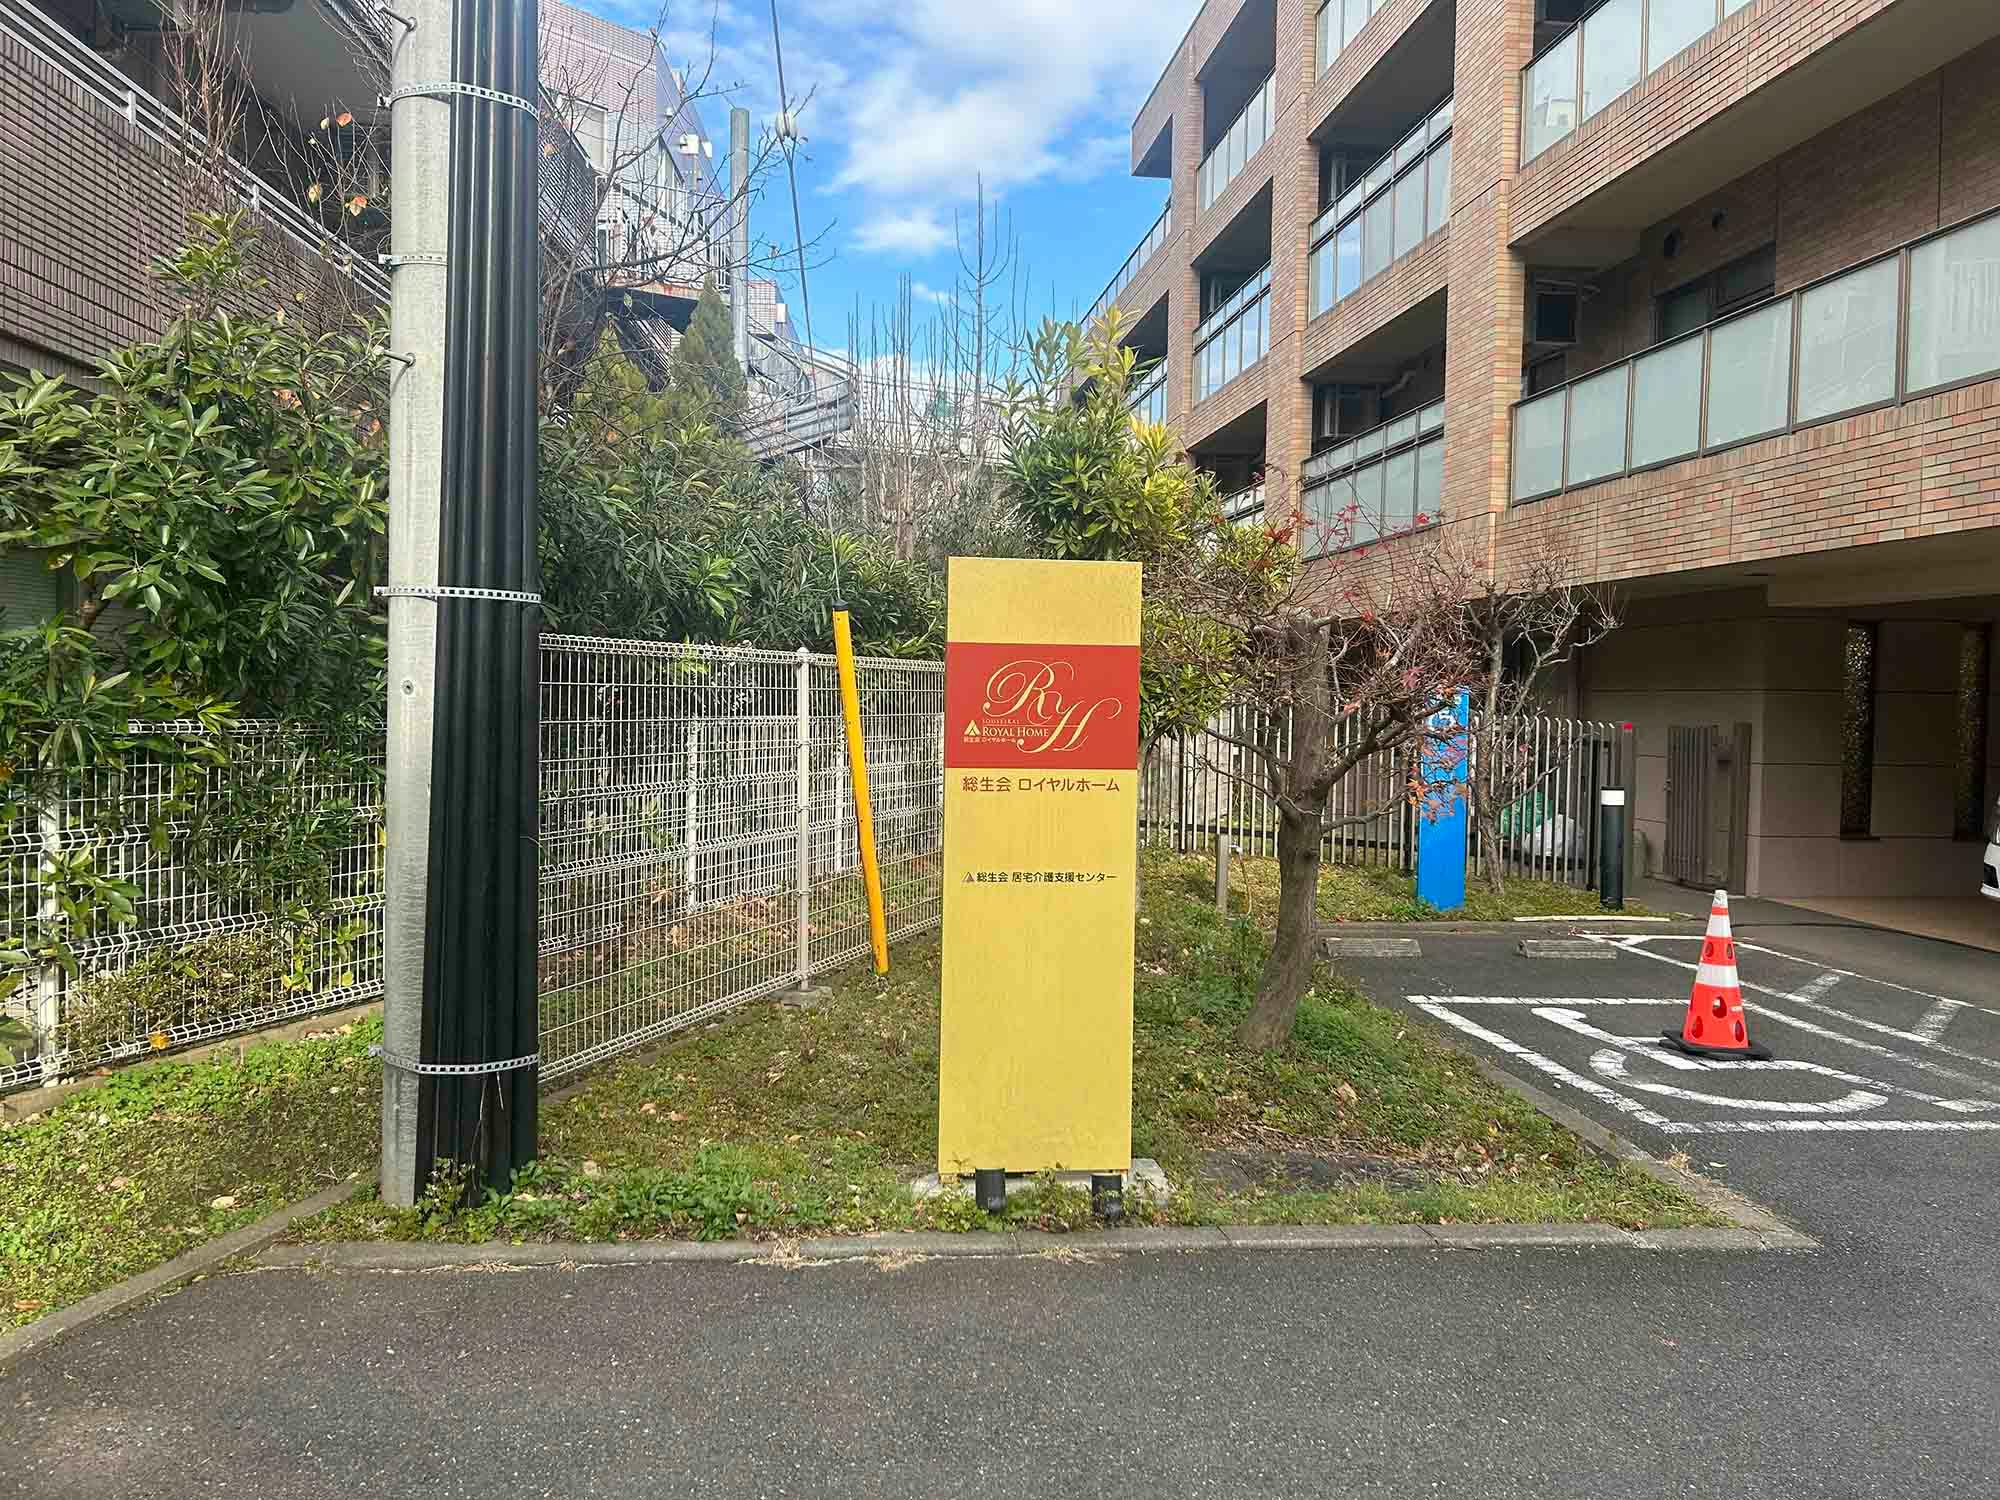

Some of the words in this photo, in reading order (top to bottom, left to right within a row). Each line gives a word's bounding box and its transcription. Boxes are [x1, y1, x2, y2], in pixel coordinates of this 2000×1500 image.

[982, 726, 1015, 737] ROYAL
[1017, 726, 1049, 737] HOME
[962, 776, 1012, 792] 総生会
[1018, 777, 1120, 792] ロイヤルホーム
[976, 872, 1009, 883] 総生会
[1012, 872, 1118, 883] 居宅介護支援センター
